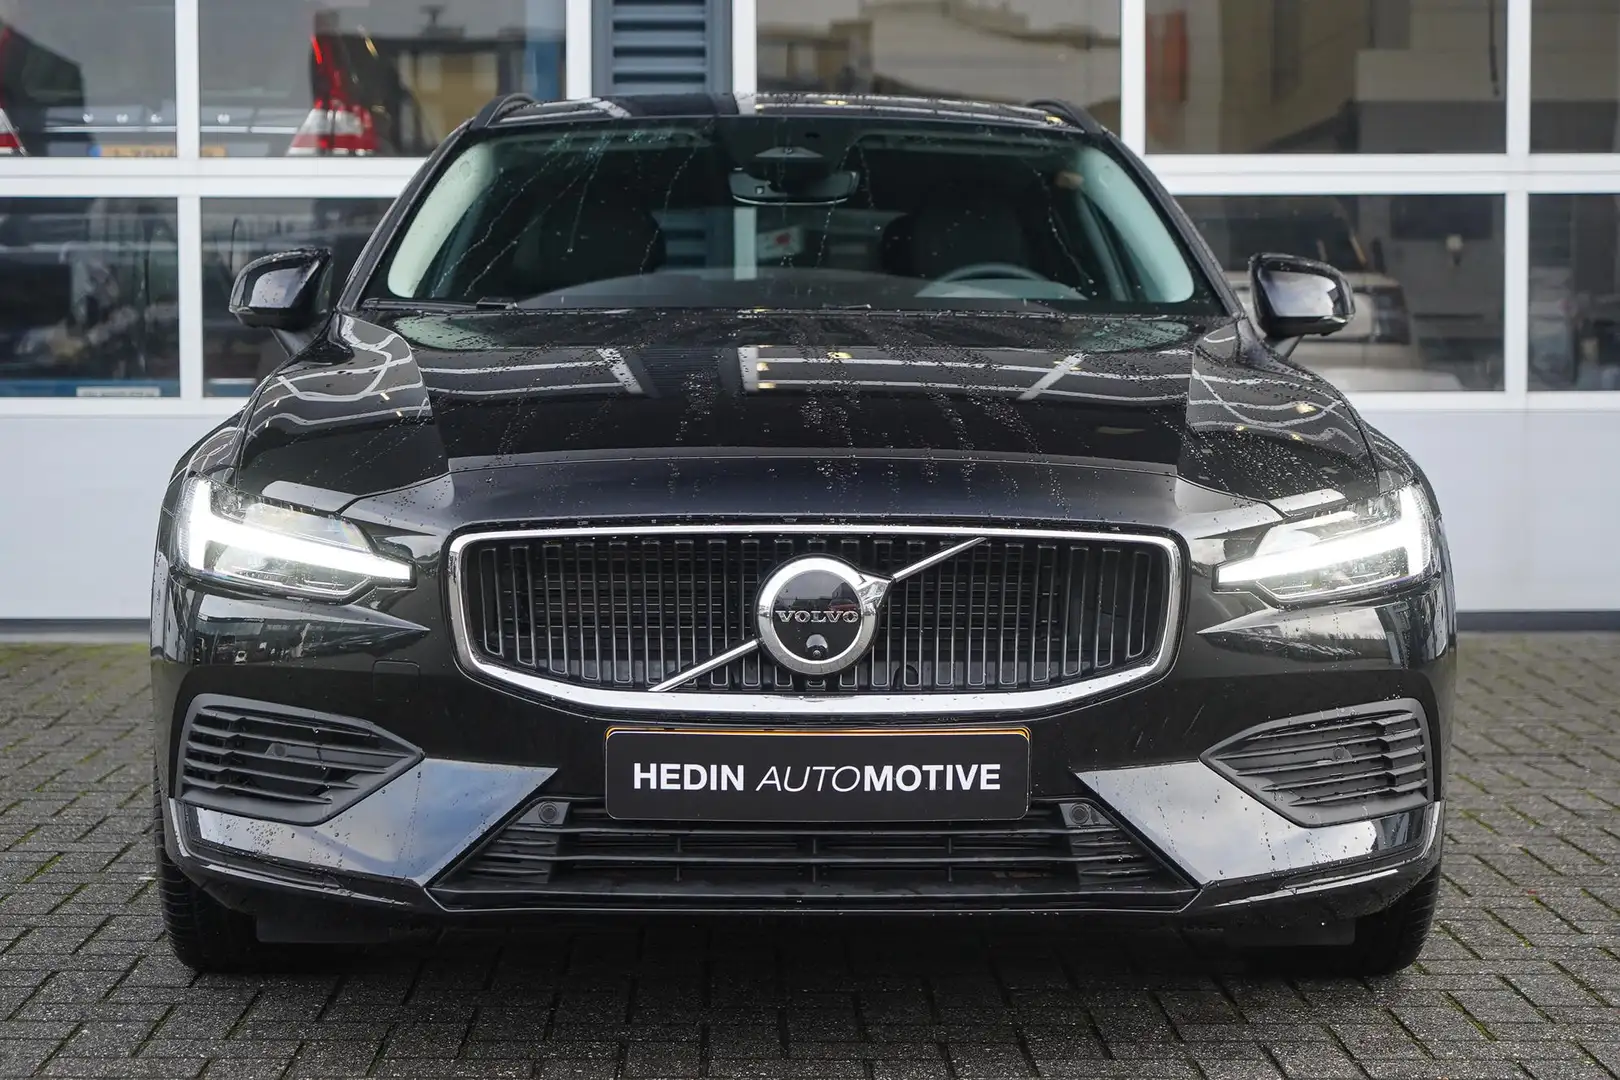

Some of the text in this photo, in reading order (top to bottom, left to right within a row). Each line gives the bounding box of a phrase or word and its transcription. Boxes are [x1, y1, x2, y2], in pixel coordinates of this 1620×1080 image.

[775, 610, 859, 623] VOLVO
[633, 762, 1001, 793] HEDIN AUTOMOTIVE
